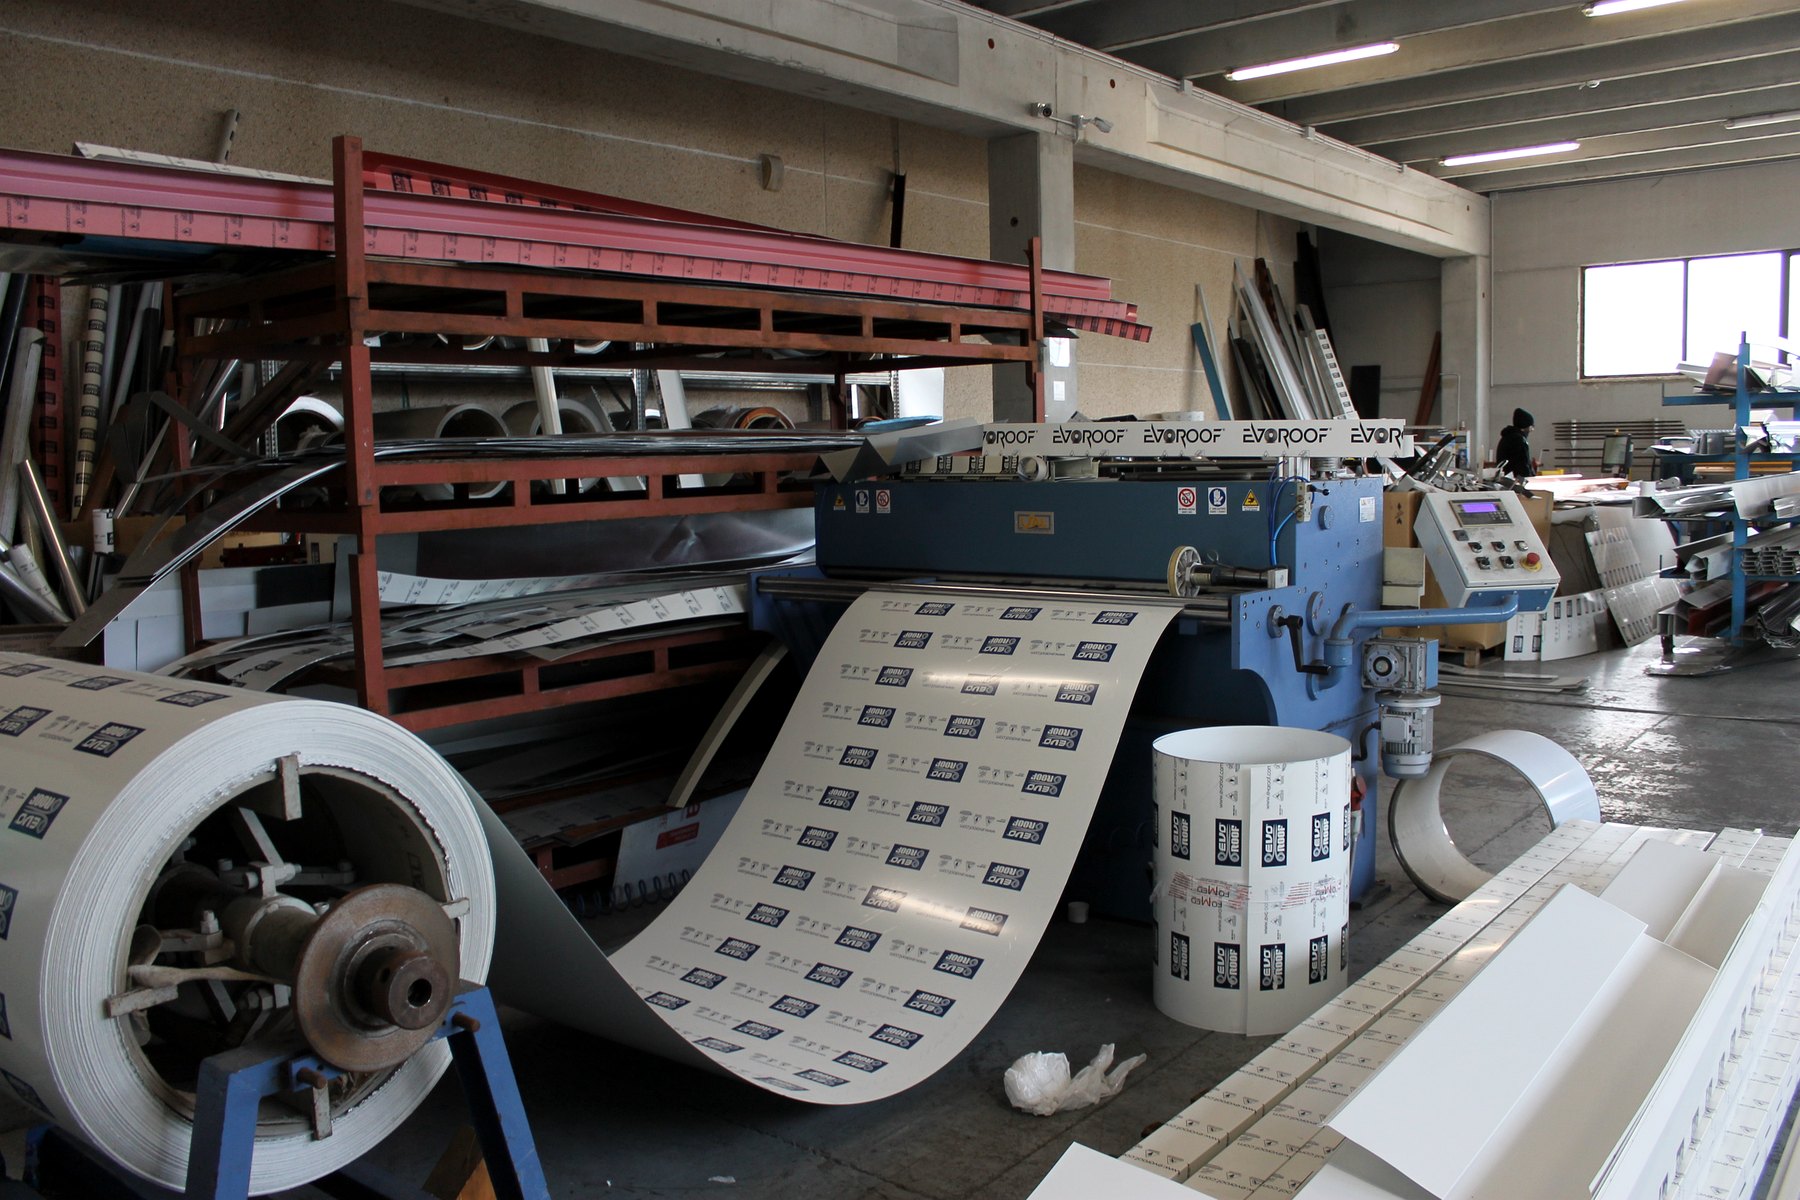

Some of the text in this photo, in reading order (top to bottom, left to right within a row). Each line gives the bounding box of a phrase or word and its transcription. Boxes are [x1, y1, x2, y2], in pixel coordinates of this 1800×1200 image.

[982, 430, 1036, 448] OROOF
[1052, 425, 1126, 448] EVOROOF
[1144, 424, 1222, 448] EVOROOF
[1242, 421, 1329, 449] EVOROOF
[1350, 421, 1404, 449] EVOR
[884, 668, 904, 676] ROOF
[952, 718, 974, 726] ROOF
[1047, 728, 1071, 737] ROOF
[1043, 738, 1067, 747] EVO
[848, 748, 868, 756] ROOF
[843, 757, 864, 765] EVO
[935, 761, 957, 769] ROOF
[930, 770, 953, 778] EVO
[1030, 773, 1054, 783] ROOF
[828, 789, 849, 798] ROOF
[1026, 784, 1050, 793] EVO
[823, 798, 844, 806] EVO
[915, 805, 938, 813] ROOF
[15, 813, 41, 829] EVO
[911, 814, 934, 822] EVO
[1012, 819, 1036, 830] ROOF
[807, 829, 828, 838] ROOF
[1007, 830, 1032, 840] EVO
[1218, 823, 1227, 851] EVO
[1265, 824, 1273, 852] EVO
[1276, 824, 1285, 852] ROOF
[802, 838, 823, 847] EVO
[1230, 825, 1240, 853] ROOF
[895, 847, 918, 856] ROOF
[890, 856, 913, 866] EVO
[783, 868, 805, 878] ROOF
[992, 866, 1017, 876] ROOF
[777, 876, 800, 886] EVO
[987, 876, 1013, 886] EVO
[866, 898, 890, 908] EVO
[757, 905, 779, 915] ROOF
[750, 913, 773, 923] EVO
[971, 910, 996, 921] ROOF
[846, 928, 870, 939] ROOF
[727, 940, 749, 949] ROOF
[840, 937, 864, 947] EVO
[720, 947, 743, 956] EVO
[945, 953, 971, 965] ROOF
[1217, 947, 1225, 974] EVO
[1229, 948, 1238, 976] ROOF
[1263, 949, 1271, 976] EVO
[1275, 949, 1283, 976] ROOF
[816, 965, 841, 976] ROOF
[938, 963, 965, 974] EVO
[810, 973, 834, 983] EVO
[783, 998, 807, 1007] ROOF
[916, 993, 942, 1004] ROOF
[775, 1004, 800, 1013] EVO
[909, 1001, 936, 1012] EVO
[882, 1027, 910, 1038] ROOF
[874, 1033, 902, 1044] EVO
